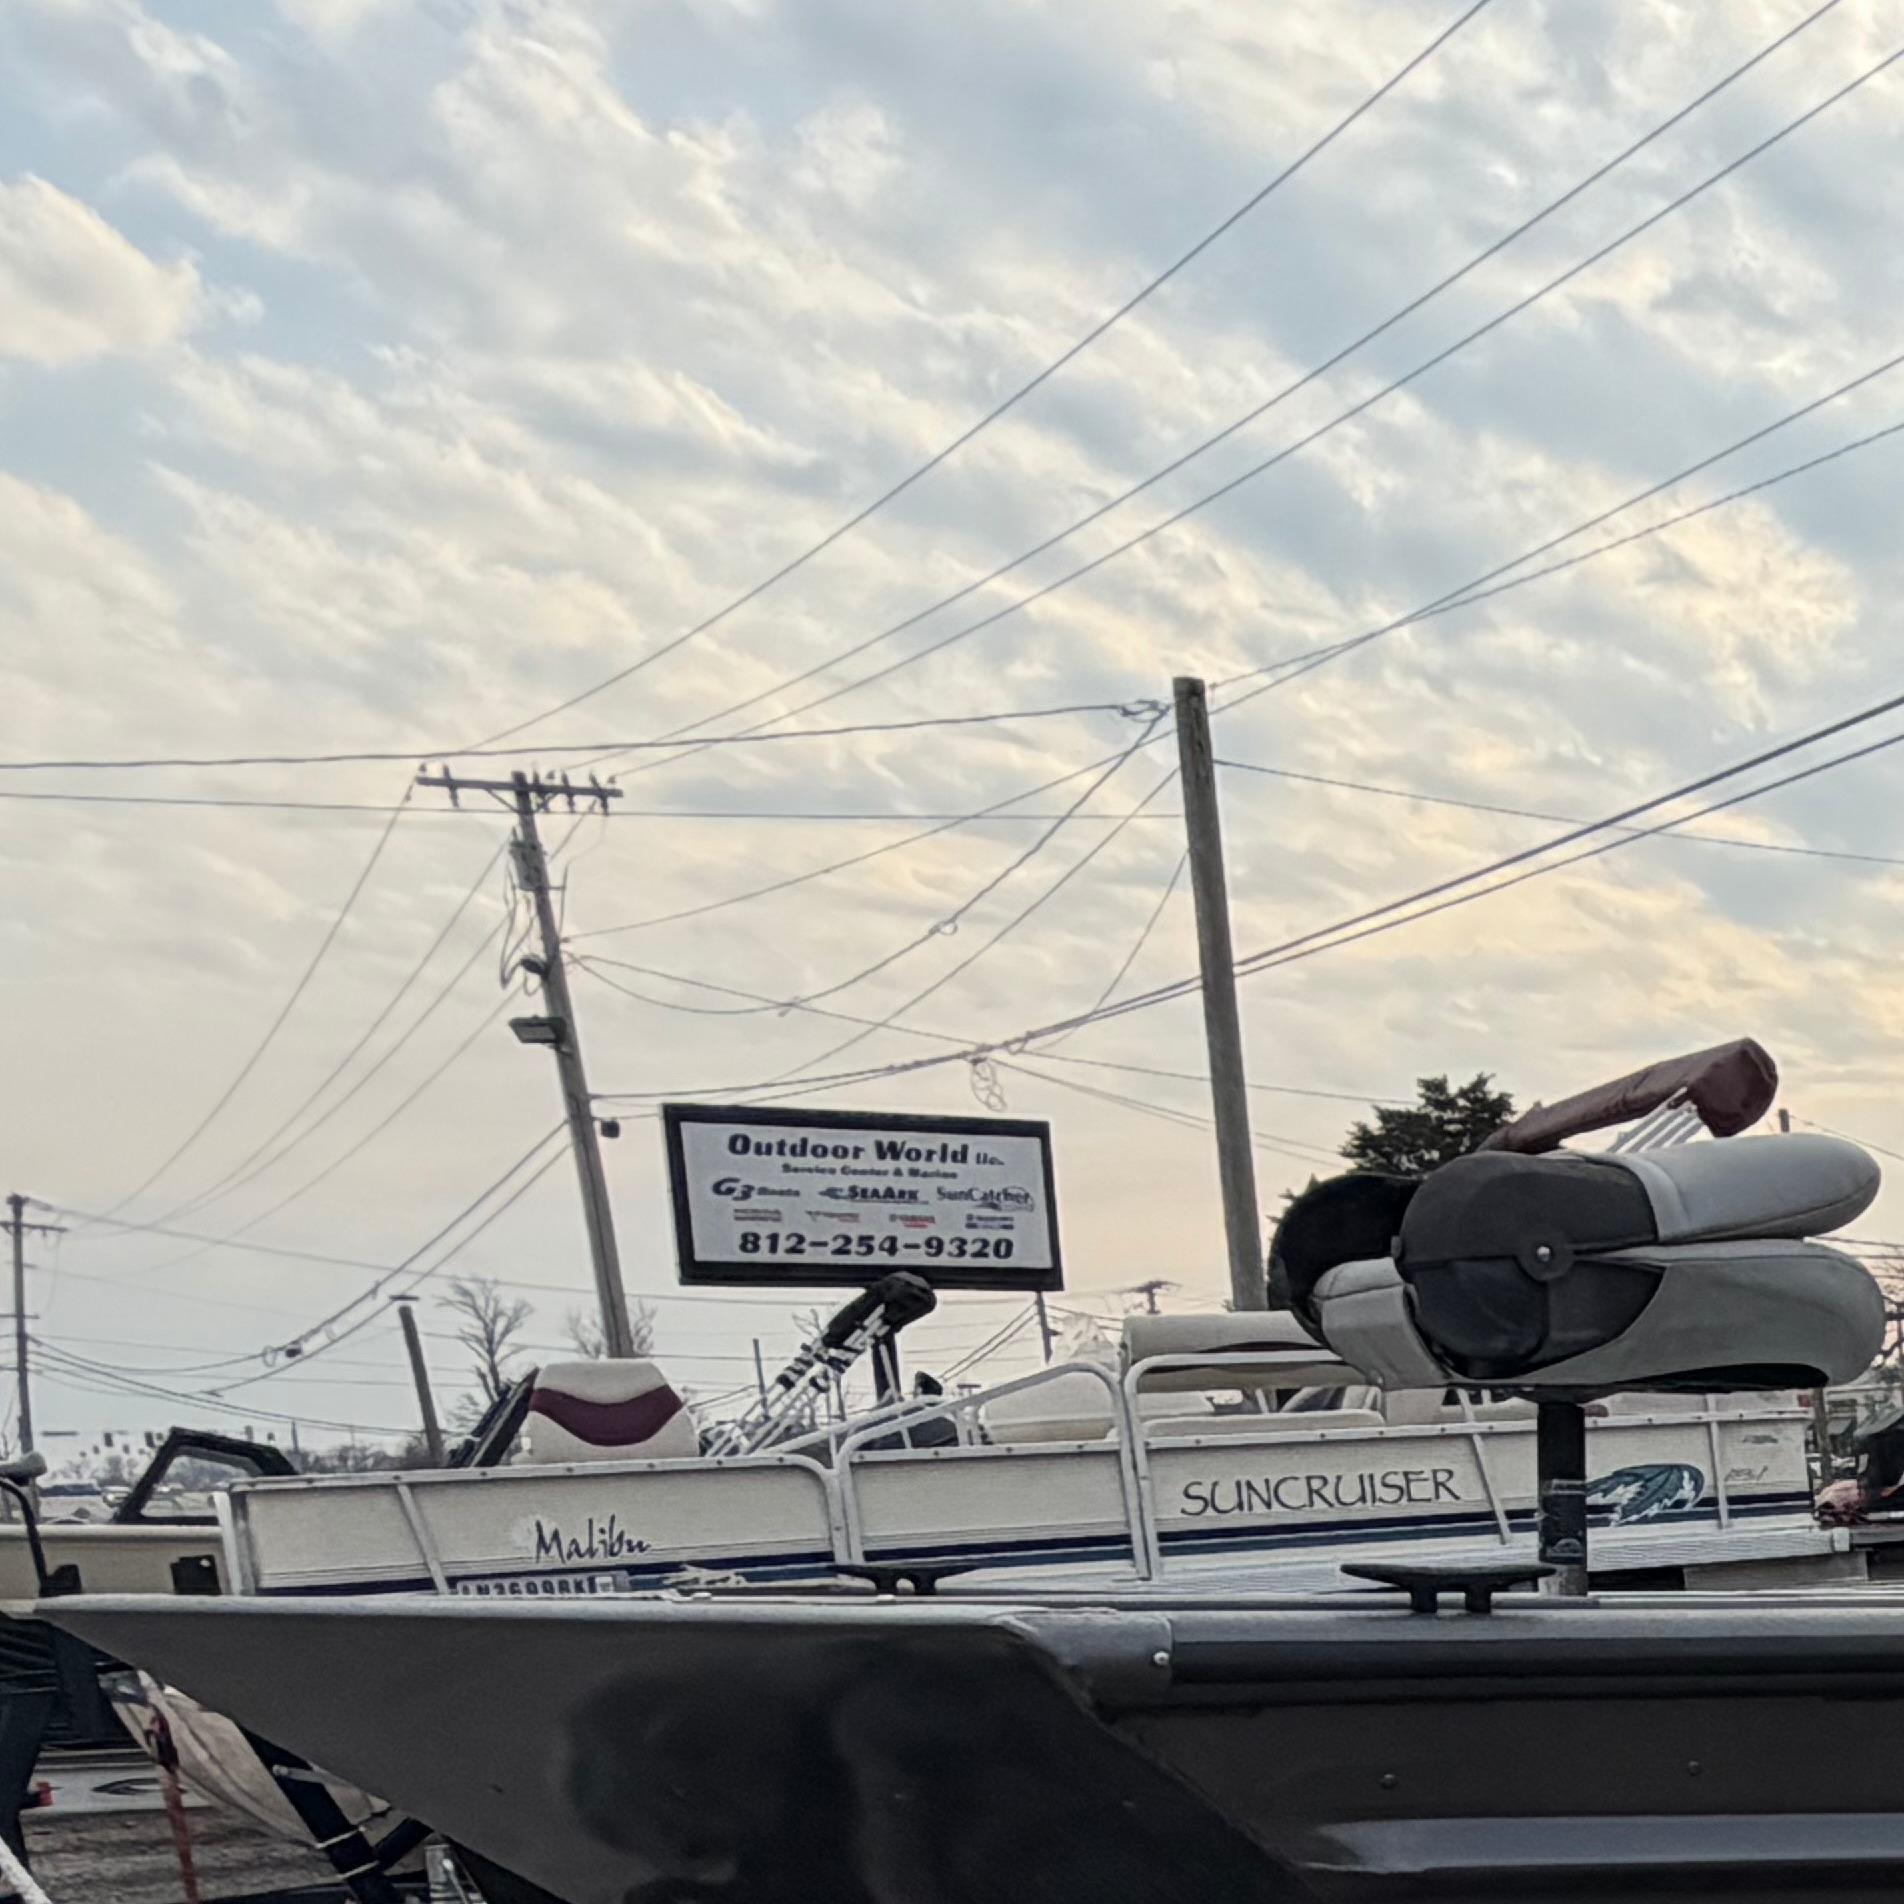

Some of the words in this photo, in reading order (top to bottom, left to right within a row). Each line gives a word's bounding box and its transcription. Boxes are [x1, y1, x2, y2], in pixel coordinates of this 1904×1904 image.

[728, 1133, 865, 1159] Outdoor
[875, 1139, 969, 1164] World
[712, 1177, 755, 1201] G3
[738, 1231, 1015, 1260] 812-254-9320
[1180, 1468, 1461, 1516] SUNCRUISER
[535, 1513, 651, 1565] Malibu
